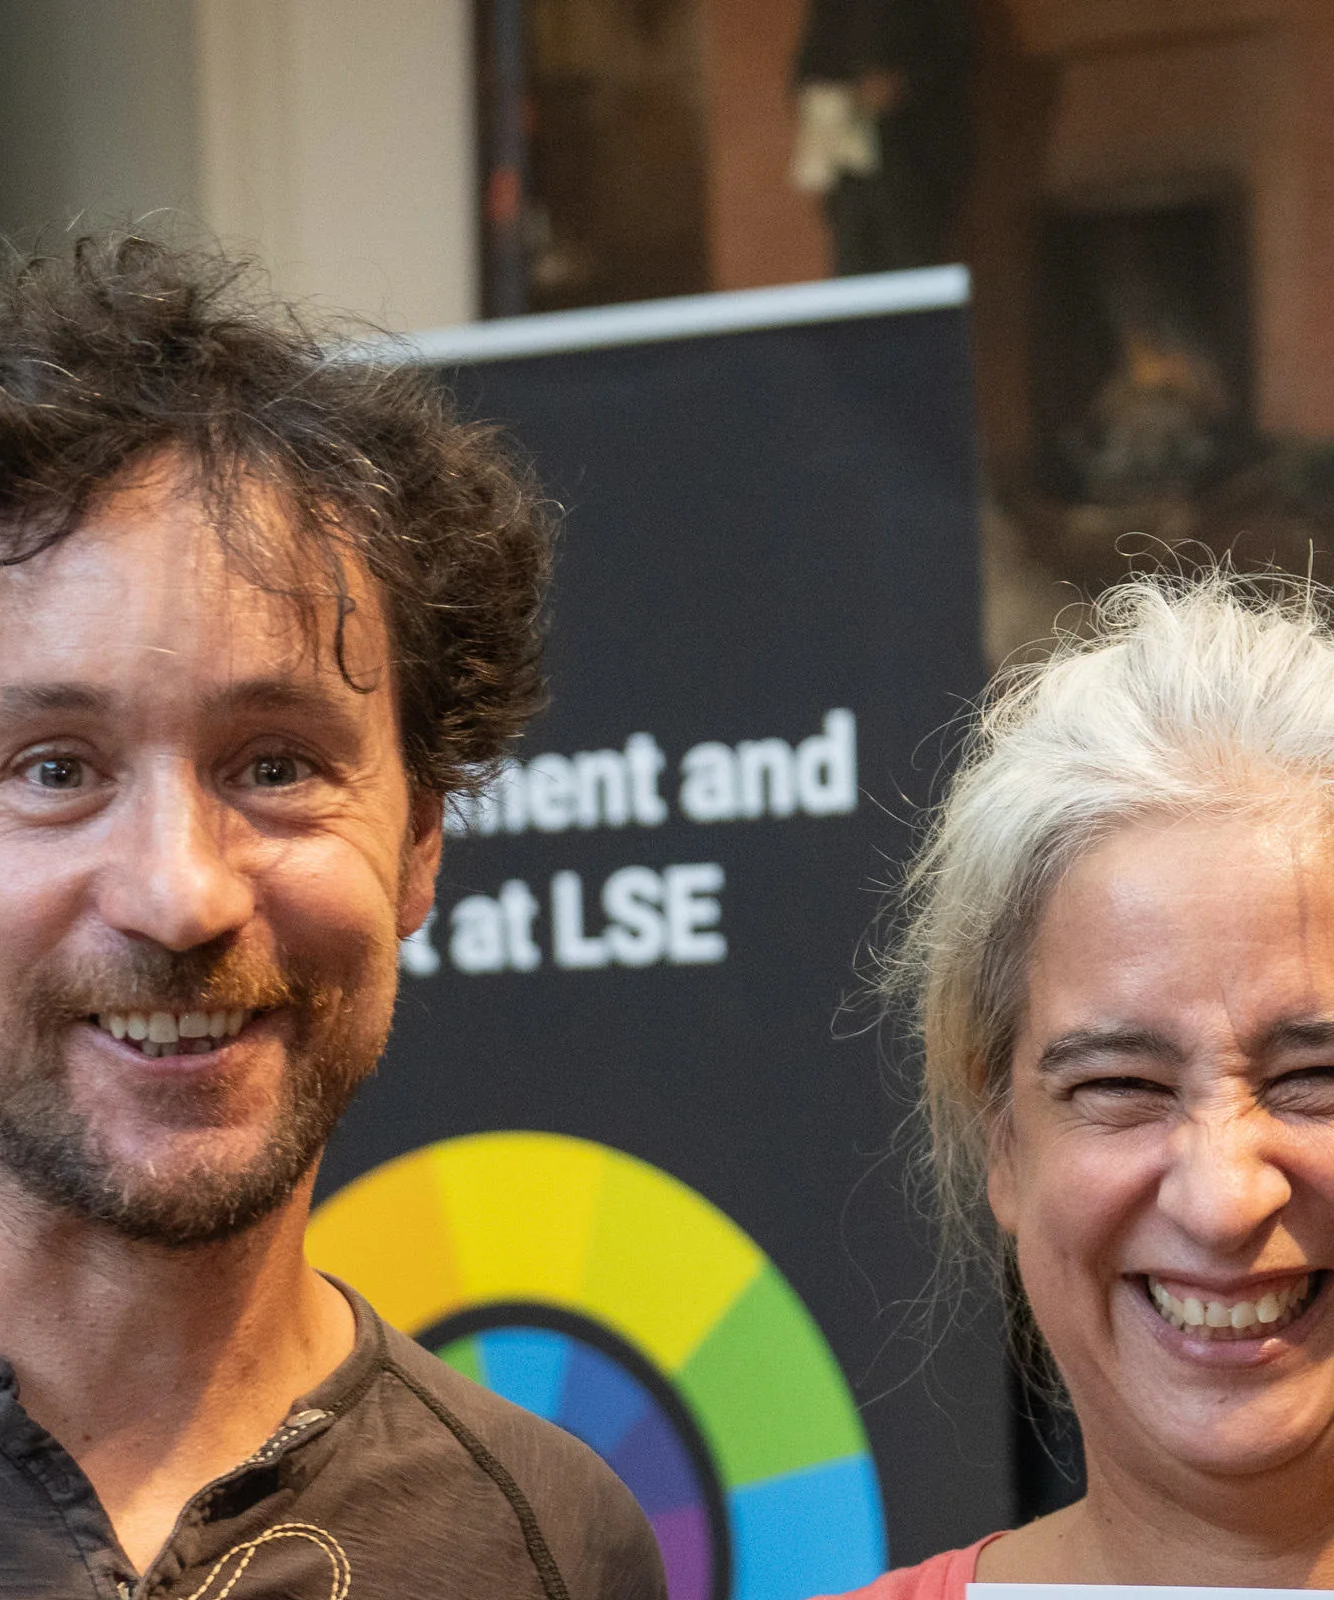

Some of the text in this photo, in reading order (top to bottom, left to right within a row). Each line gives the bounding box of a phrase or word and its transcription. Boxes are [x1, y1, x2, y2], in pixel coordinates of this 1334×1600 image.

[680, 707, 858, 823] and
[449, 878, 542, 975] at
[551, 861, 727, 971] LSE
